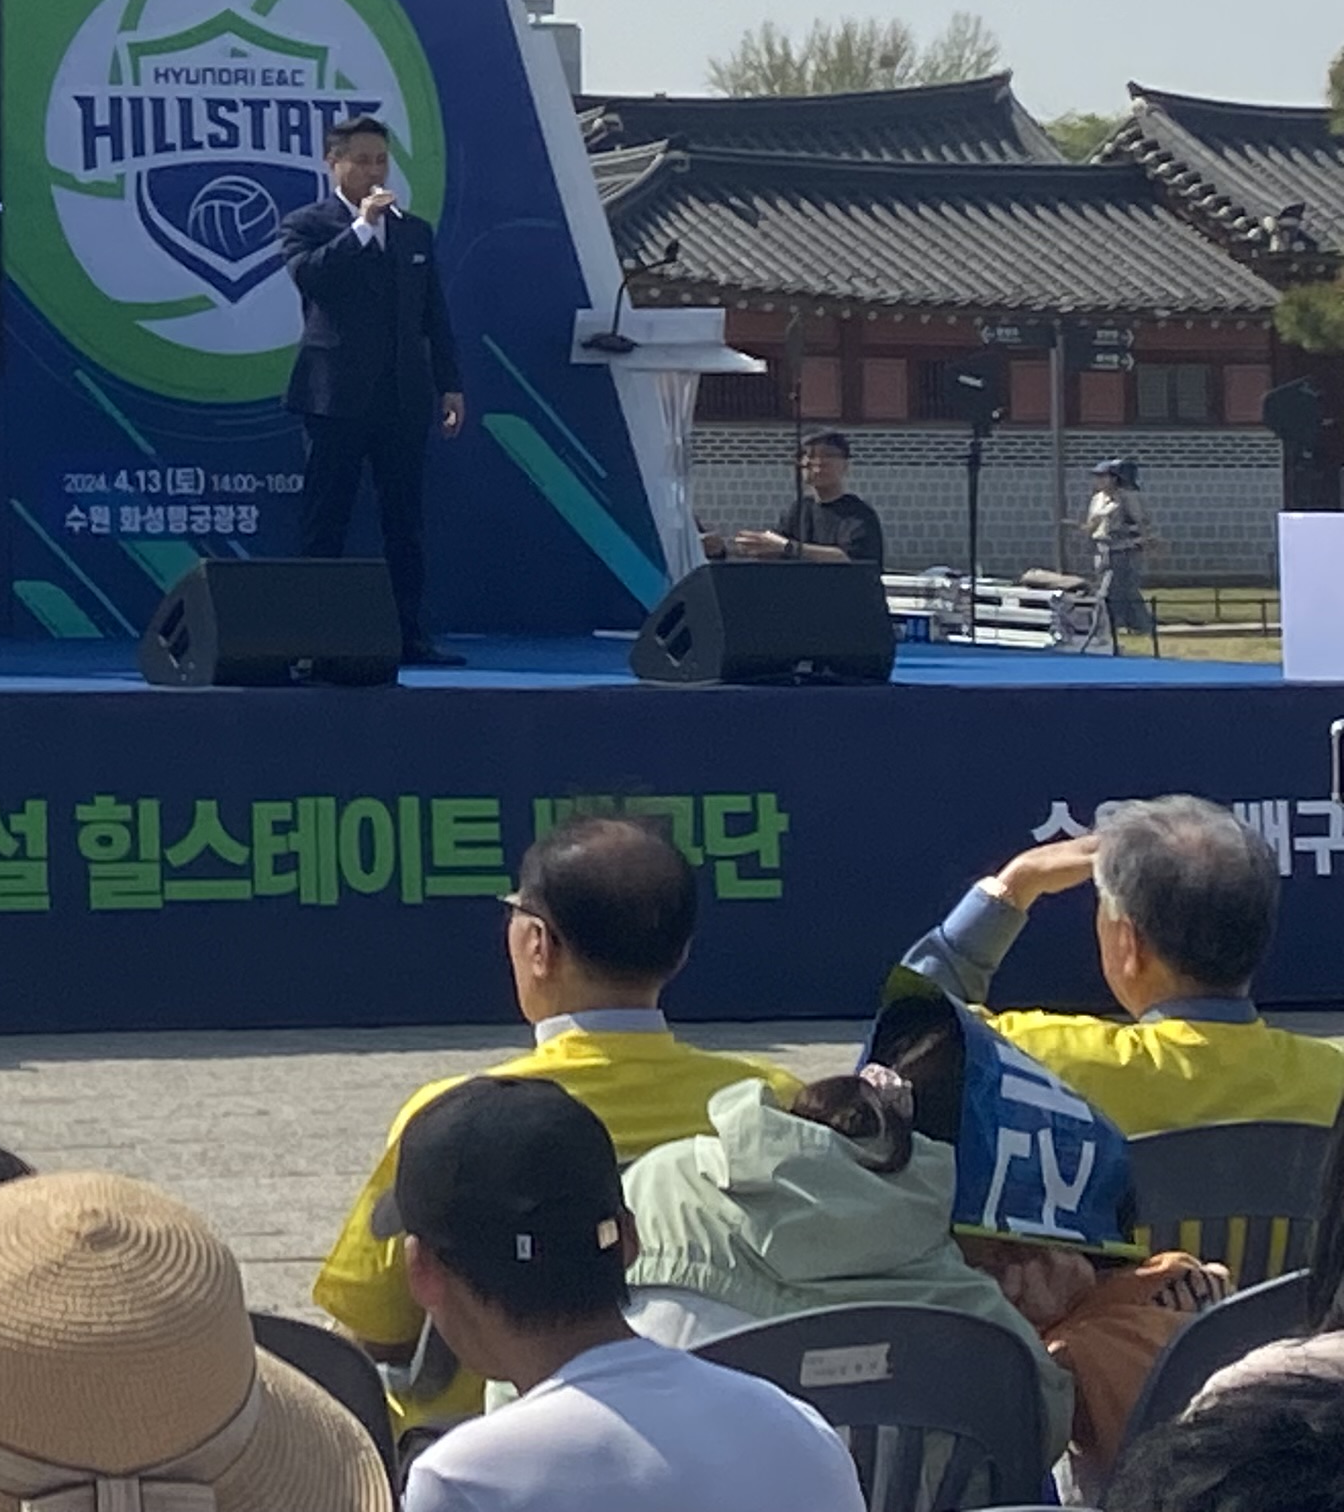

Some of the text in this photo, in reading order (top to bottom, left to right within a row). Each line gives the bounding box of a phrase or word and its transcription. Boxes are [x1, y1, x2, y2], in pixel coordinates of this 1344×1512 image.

[154, 66, 304, 87] HYUNDAI E&C
[73, 95, 383, 172] HILLSTAT
[114, 470, 160, 492] 4.13
[166, 468, 205, 494] (토)
[65, 504, 259, 534] 수원 화성행궁광장
[75, 793, 512, 910] 힐스테이트
